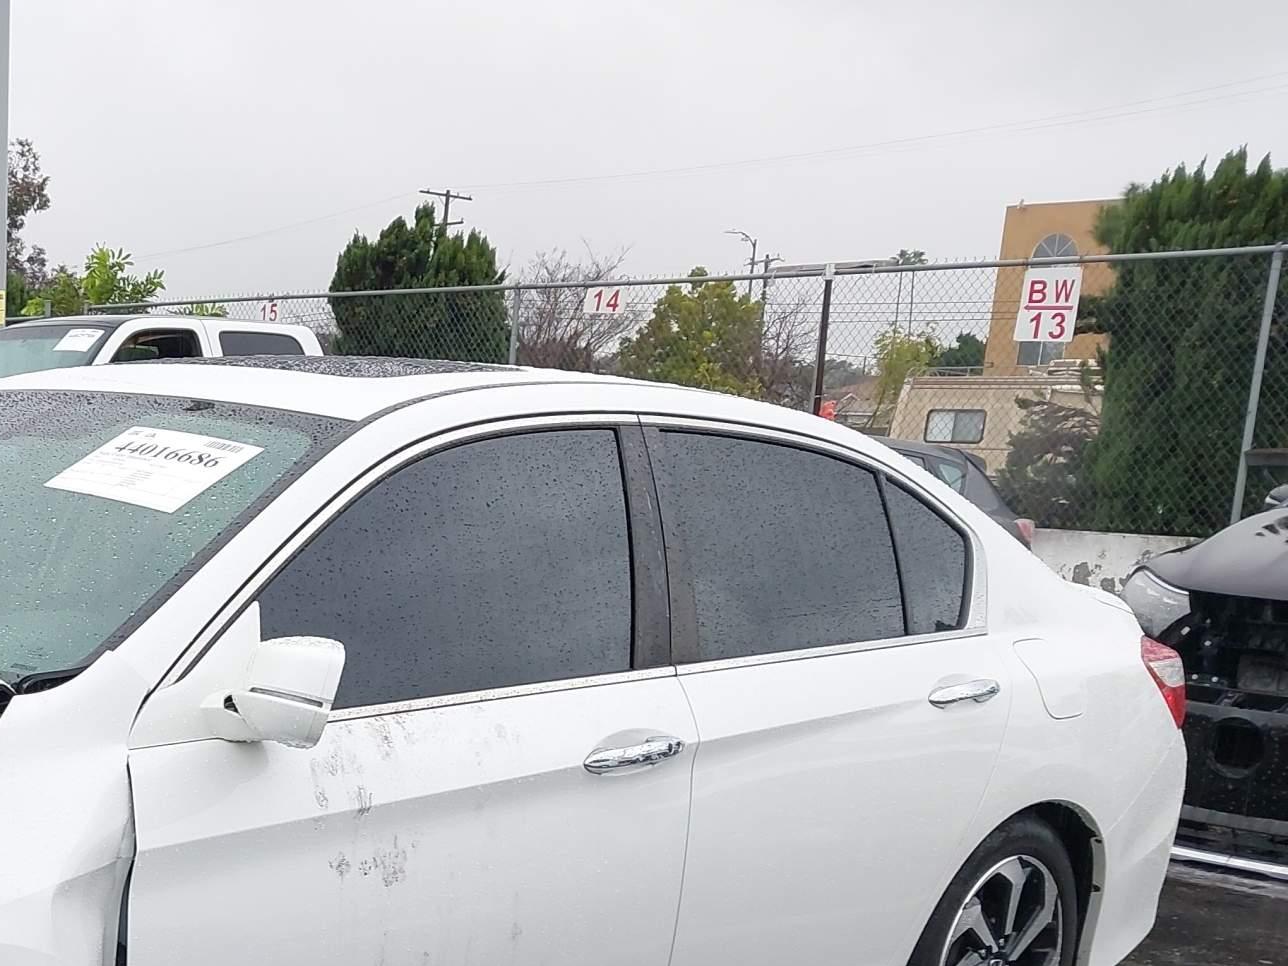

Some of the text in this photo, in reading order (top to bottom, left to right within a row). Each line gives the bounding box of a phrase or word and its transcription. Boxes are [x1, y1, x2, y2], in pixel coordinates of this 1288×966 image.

[260, 303, 278, 322] 15
[593, 289, 620, 312] 14
[1029, 311, 1066, 340] 13
[114, 441, 227, 468] 44016686
